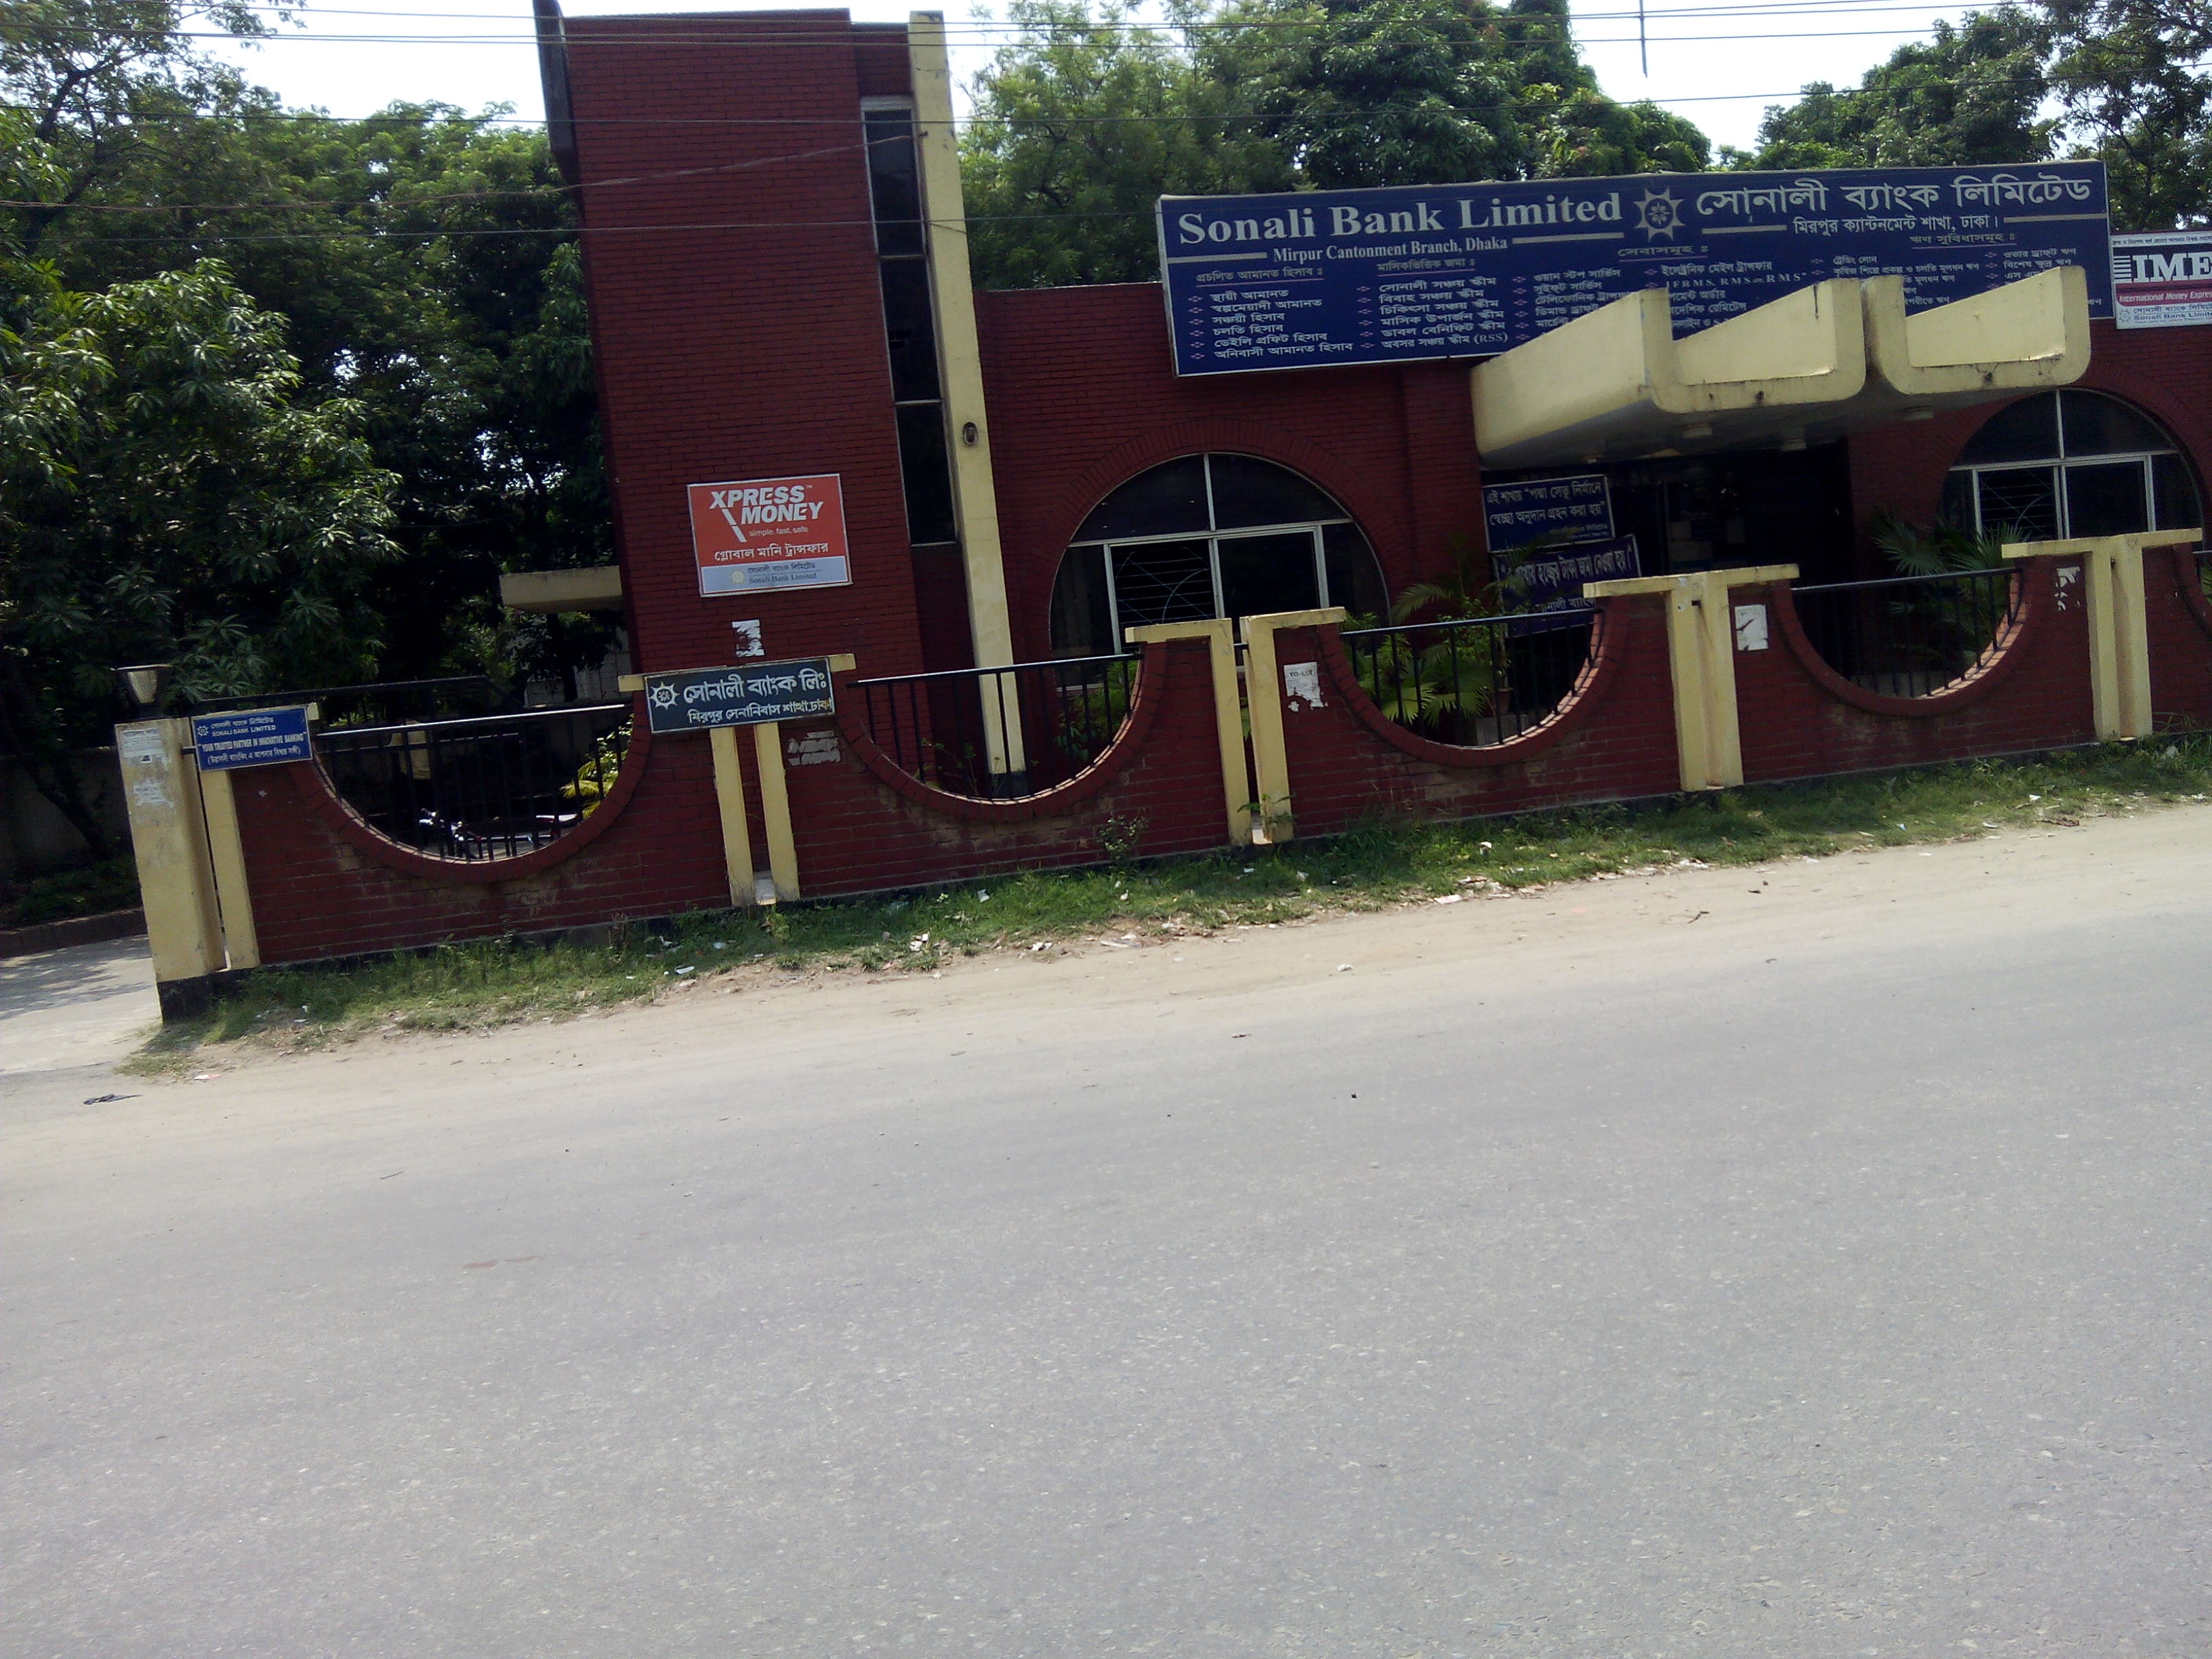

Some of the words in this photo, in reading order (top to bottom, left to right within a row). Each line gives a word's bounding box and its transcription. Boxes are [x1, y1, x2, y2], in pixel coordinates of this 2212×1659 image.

[1696, 177, 1829, 216] সোনালী
[1839, 184, 1941, 211] ব্যাংক
[1950, 171, 2093, 207] লিমিটেড
[1178, 207, 1317, 245] Sonali
[1328, 201, 1446, 237] Bank
[1458, 192, 1624, 229] Limited
[1793, 216, 1839, 237] মিরপুর
[1273, 247, 1323, 265] Mirpur
[1326, 243, 1407, 260] Cantonment
[1411, 238, 1462, 255] Branch,
[1465, 236, 1508, 251] Dhaka
[1237, 269, 1280, 280] আমানত
[1282, 266, 1314, 277] হিসাব
[1378, 279, 1428, 293] সোনালী
[1241, 289, 1289, 300] আমানত
[1378, 293, 1416, 304] বিবাহ
[2119, 293, 2164, 303] International
[2166, 291, 2188, 300] Money
[1275, 299, 1324, 309] আমানত
[1250, 312, 1286, 323] হিসাব
[1380, 315, 1422, 327] মাসিক
[1212, 325, 1246, 336] চলতি
[1250, 323, 1284, 334] হিসাব
[1380, 327, 1417, 337] ডাবল
[1214, 336, 1252, 348] ডেইলি
[1293, 331, 1328, 343] হিসাব
[1474, 331, 1509, 345] (RSS)
[1213, 347, 1265, 359] অনিবাসী
[1267, 344, 1315, 355] আমানত
[1319, 342, 1354, 353] হিসাব
[710, 485, 805, 510] XPRESS
[741, 501, 824, 525] MONEY
[714, 548, 754, 561] গ্লোবাল
[757, 543, 781, 557] মানি
[749, 575, 771, 584] Sonali
[772, 574, 789, 582] Bank
[791, 572, 817, 581] Limited
[683, 673, 745, 703] সোনালী
[747, 674, 798, 697] ব্যাংক
[687, 707, 723, 724] মিরপুর
[725, 703, 781, 720] সেনানিবাস
[212, 729, 233, 737] SONALI
[250, 724, 276, 733] LIMITED
